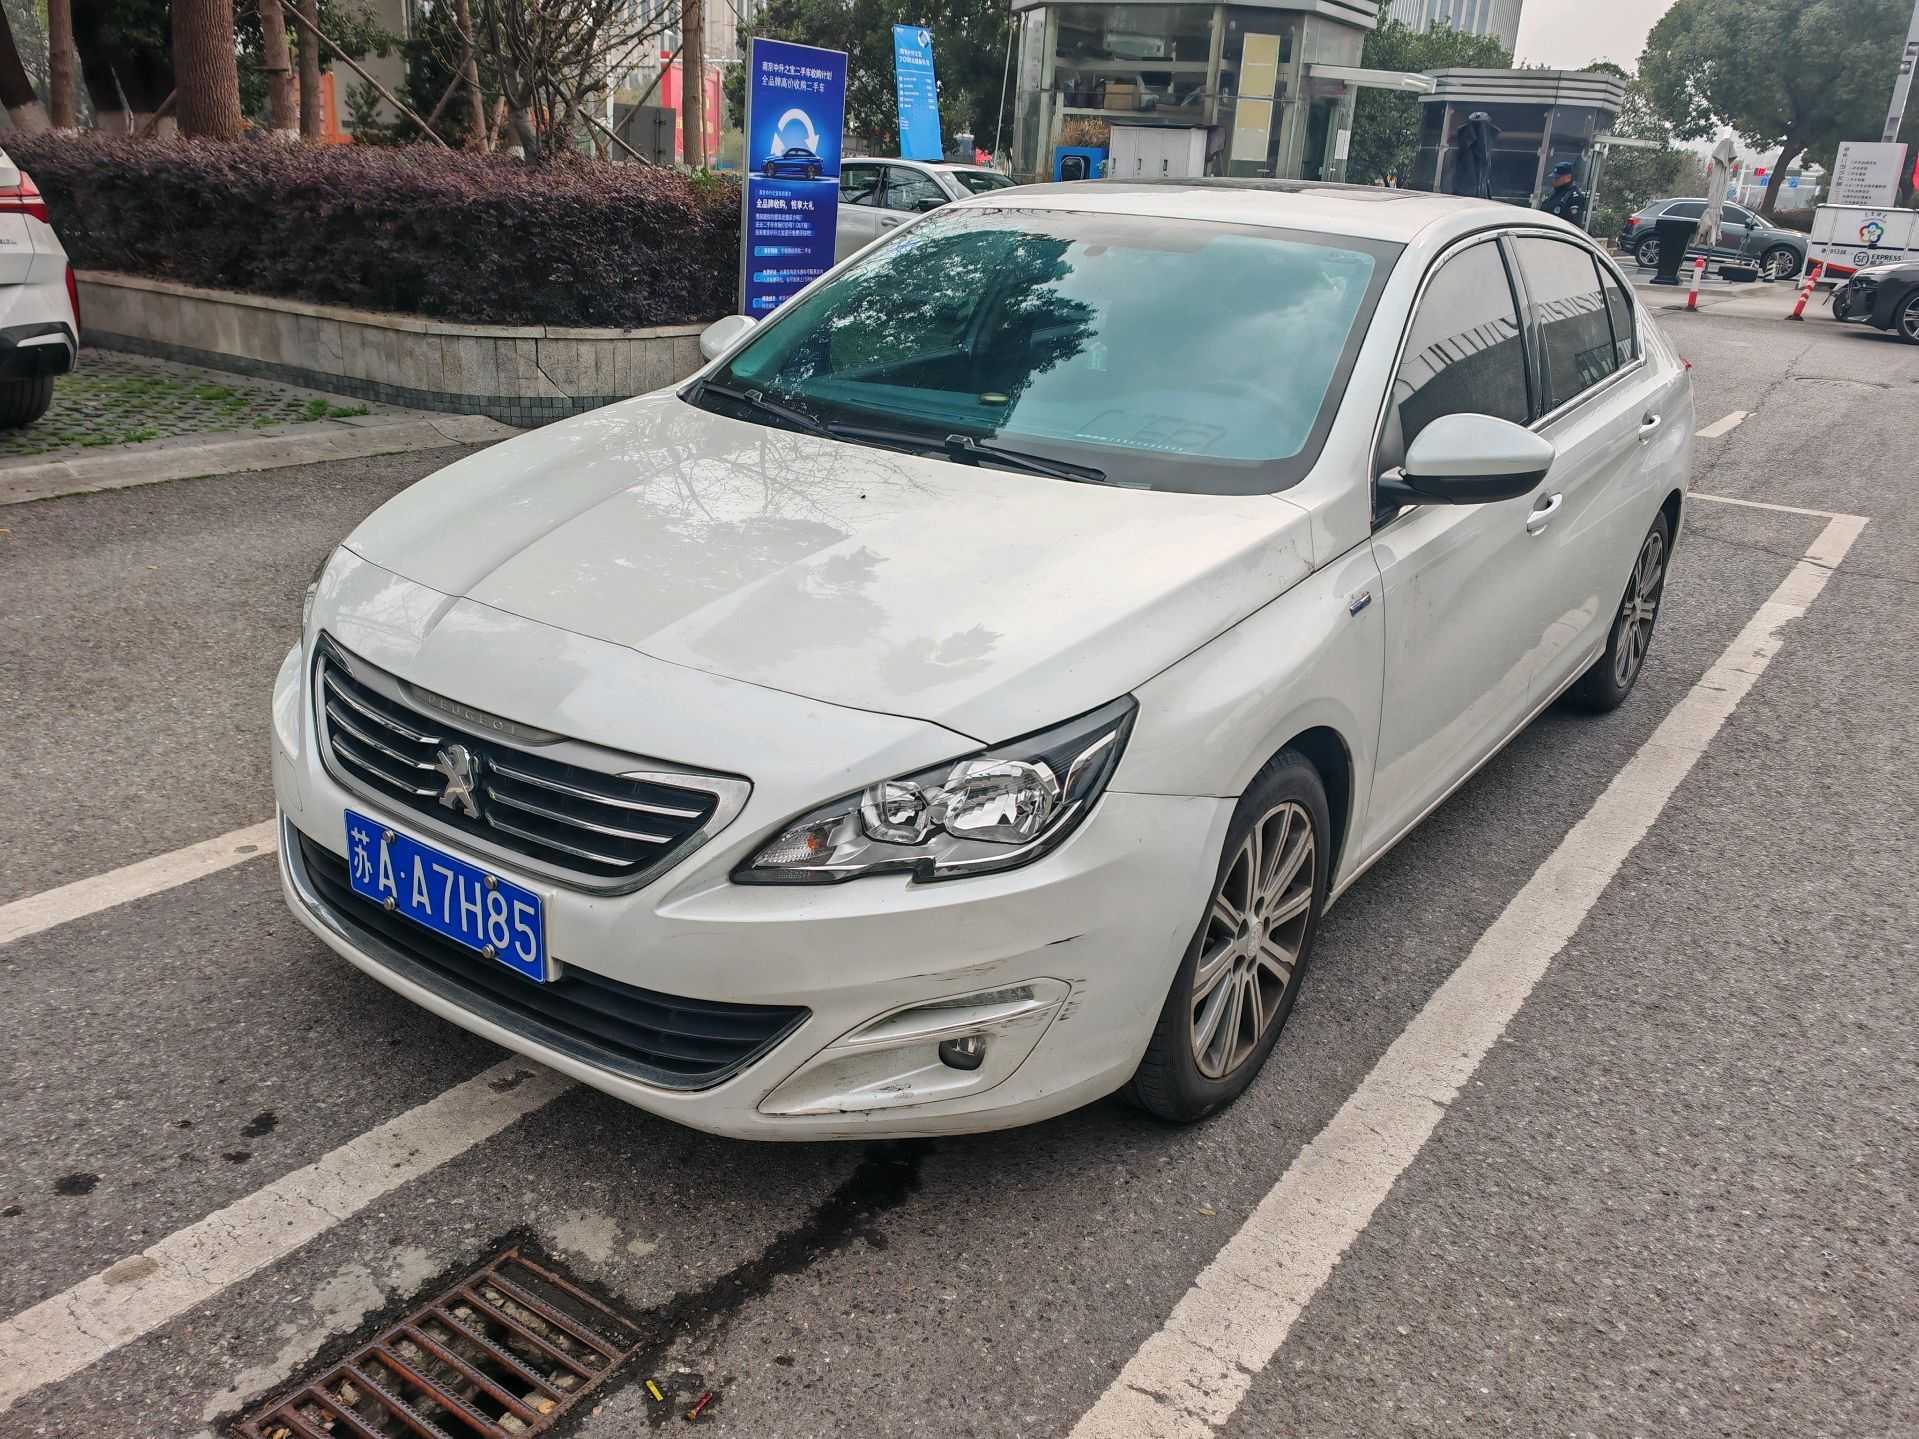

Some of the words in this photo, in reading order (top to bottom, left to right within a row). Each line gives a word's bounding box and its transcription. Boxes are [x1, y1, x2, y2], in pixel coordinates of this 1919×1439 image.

[761, 74, 825, 93] 全品牌高价收购二手车
[424, 694, 518, 736] PEUGEOT
